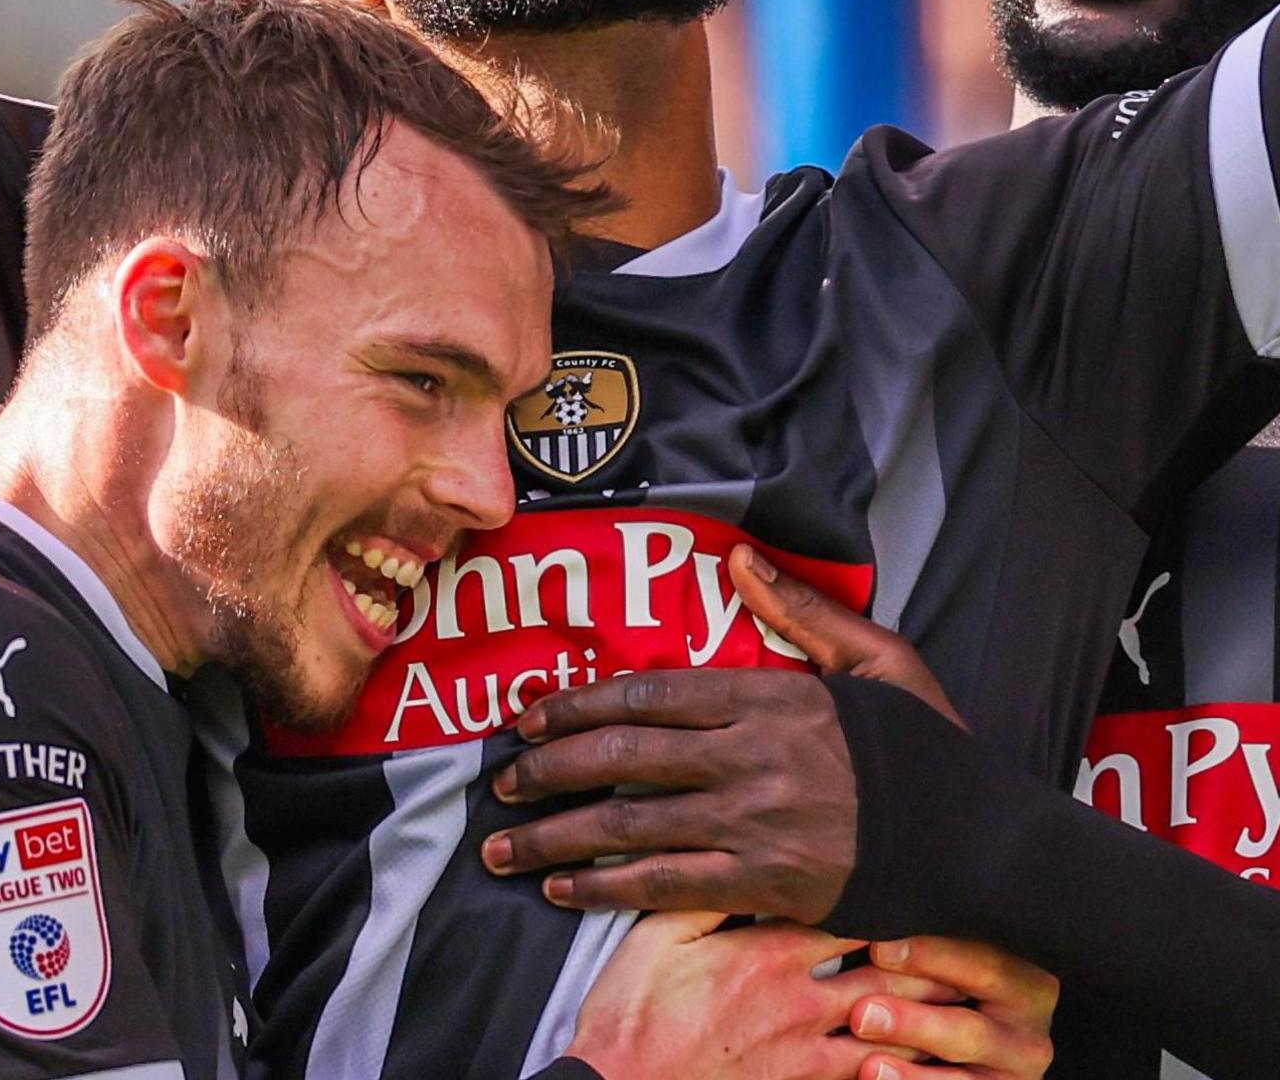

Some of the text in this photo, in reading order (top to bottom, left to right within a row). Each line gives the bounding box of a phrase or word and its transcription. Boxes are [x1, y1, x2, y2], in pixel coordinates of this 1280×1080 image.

[556, 359, 616, 367] County FC
[387, 548, 595, 644] hn
[22, 824, 76, 859] bet
[48, 866, 87, 893] TWO
[25, 982, 77, 1016] EFL
